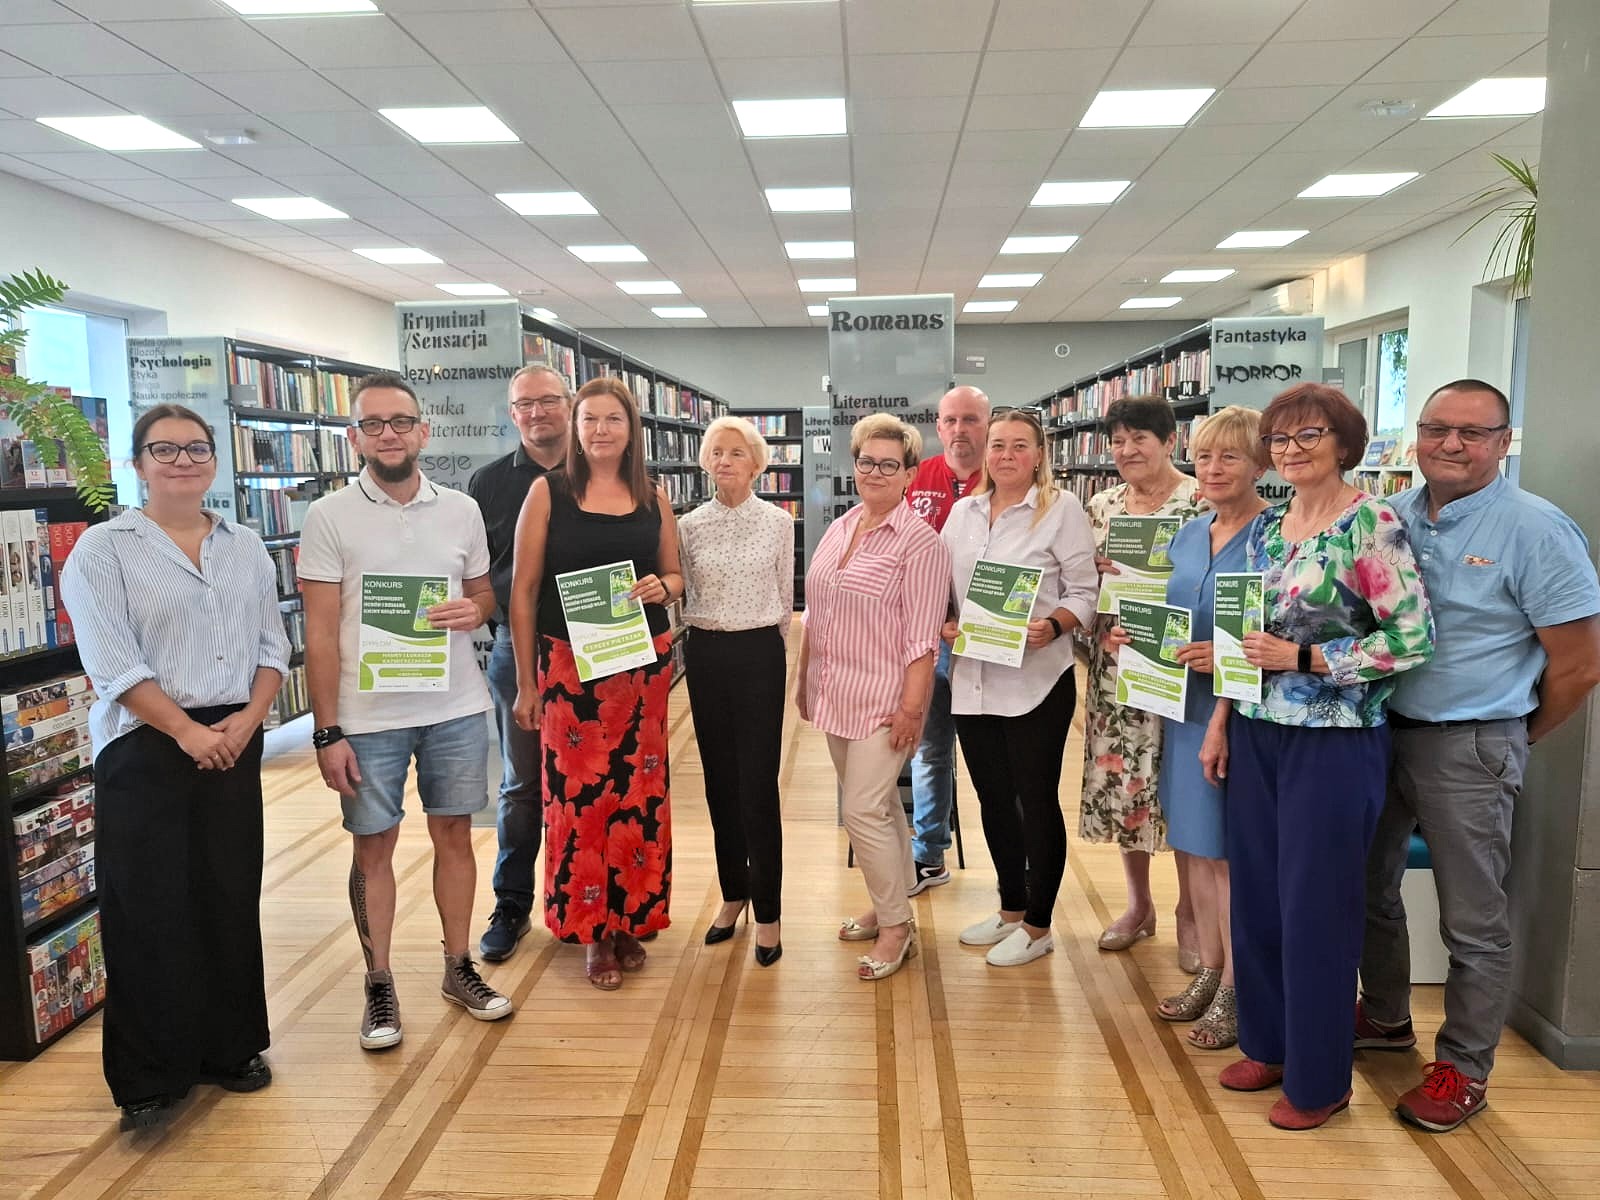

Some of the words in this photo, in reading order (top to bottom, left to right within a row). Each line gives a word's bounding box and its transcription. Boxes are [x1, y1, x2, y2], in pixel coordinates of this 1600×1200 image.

[402, 309, 486, 332] Kryminał
[831, 310, 944, 332] Romans
[403, 329, 488, 352] /Sensacja
[1215, 328, 1306, 345] Fantastyka
[130, 356, 212, 370] Psychologia
[131, 370, 158, 380] Etyka
[1216, 364, 1302, 384] HORROR
[132, 391, 158, 400] Nauki
[160, 391, 208, 401] społeczne
[1183, 382, 1192, 396] M
[832, 394, 909, 409] Literatura
[364, 580, 403, 589] KONKURS
[560, 577, 594, 589] KONKURS
[1120, 604, 1152, 615] KONKURS
